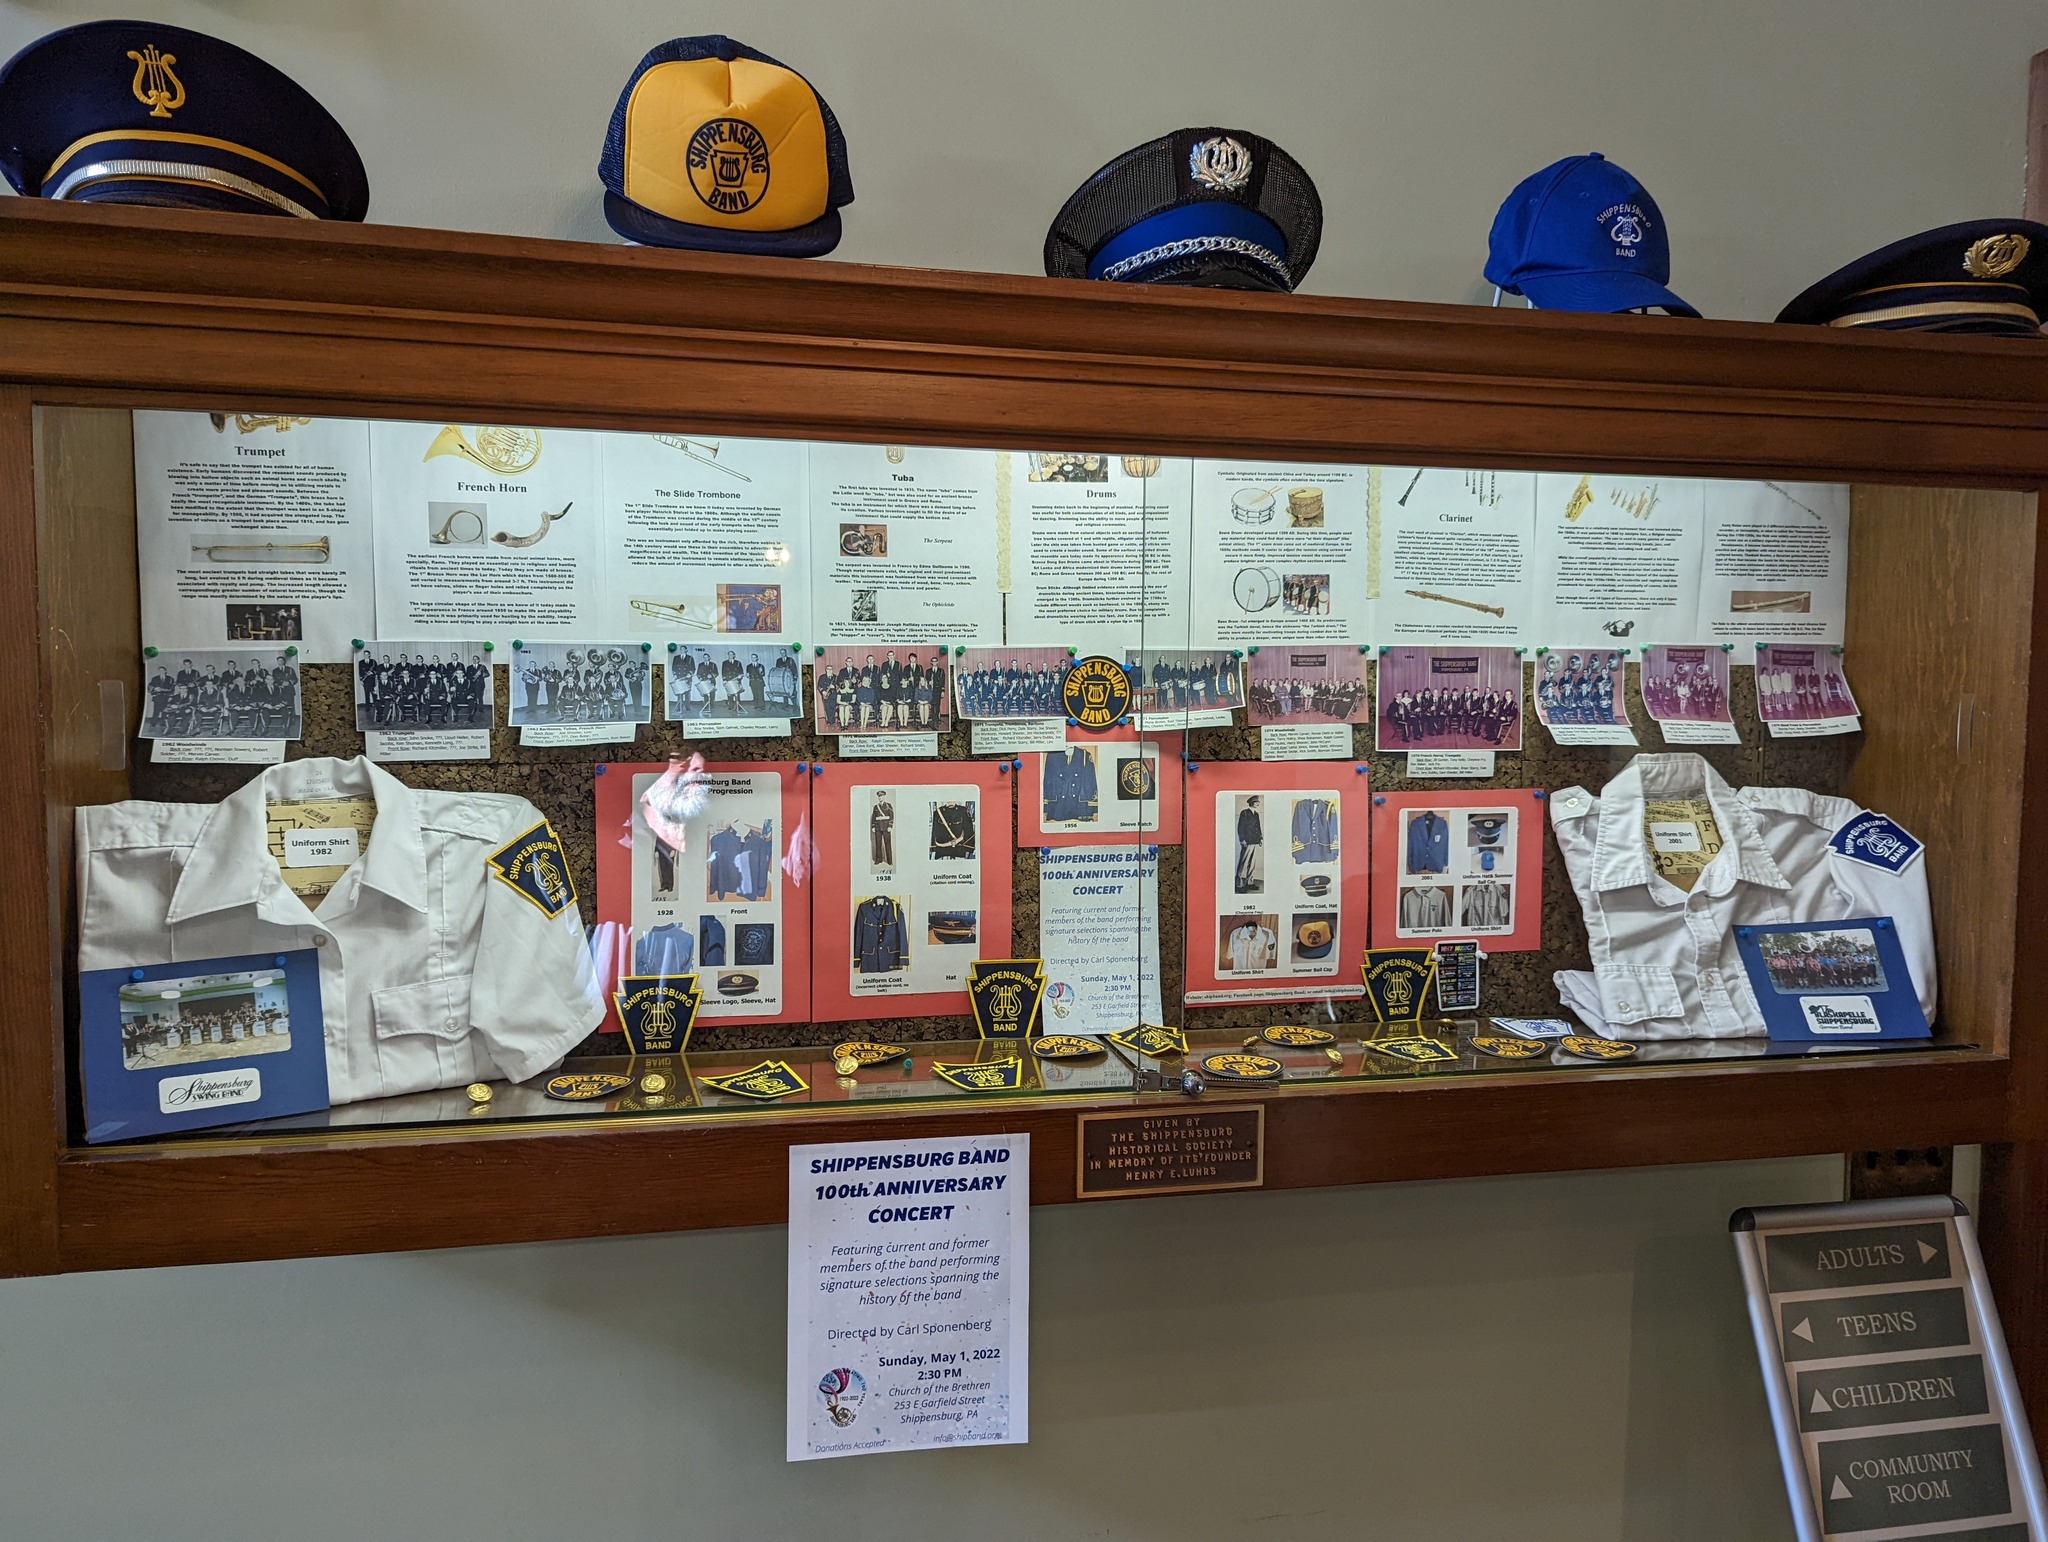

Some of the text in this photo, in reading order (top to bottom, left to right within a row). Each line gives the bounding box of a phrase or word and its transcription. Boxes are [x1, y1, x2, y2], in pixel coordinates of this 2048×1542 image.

[690, 123, 768, 174] SHIPPENSBURG
[708, 187, 750, 210] BAND
[1597, 204, 1651, 228] SHIPPENSBURG
[1616, 248, 1636, 257] BAND
[235, 446, 285, 458] Trumpet
[892, 474, 914, 482] Tuba
[458, 482, 527, 493] French Horn
[655, 489, 741, 499] The Slide Trombone
[1086, 489, 1117, 498] Drums
[1439, 514, 1473, 522] Clarinet
[1067, 662, 1126, 698] SHIPPENSBURG
[1081, 707, 1111, 724] BAND
[708, 787, 753, 795] Progression
[1845, 820, 1888, 854] SHIPPENSBURG
[510, 841, 558, 880] SHIPPENSBURG
[1040, 853, 1156, 864] SHIPPENSBURG BAND
[1889, 845, 1909, 863] BAND
[1042, 869, 1155, 880] 100th ANNIVERSARY
[1073, 886, 1123, 895] CONCERT
[1368, 958, 1428, 980] SHIPPENSBURG
[974, 971, 1038, 993] SHIPPENSBURG
[623, 987, 694, 1011] SHIPPENSBURG
[1389, 1006, 1409, 1016] BAND
[993, 1023, 1018, 1031] BAND
[645, 1040, 671, 1050] BAND
[165, 1077, 254, 1105] Shippensburg
[192, 1092, 220, 1102] SWING
[1144, 1118, 1200, 1128] GIVEN BY
[1112, 1127, 1233, 1142] THE SHIPPENSBURG
[1109, 1141, 1233, 1155] HISTORICAL SOCIETY
[810, 1149, 1010, 1173] SHIPPENSBURG BAND
[1090, 1161, 1101, 1169] IN
[1109, 1157, 1155, 1168] MEMORY
[1161, 1156, 1173, 1165] OF
[1126, 1170, 1164, 1181] HENRY
[816, 1175, 1007, 1200] 100th ANNIVERSARY
[868, 1205, 954, 1223] CONCERT
[831, 1238, 989, 1257] Featuring current and former
[820, 1254, 1000, 1274] members of the band performing
[1816, 1244, 1905, 1272] ADULTS
[820, 1270, 999, 1293] signature selections spanning the
[859, 1289, 961, 1307] history of the band
[828, 1319, 992, 1340] Directed by Carl Sponenberg
[1837, 1311, 1917, 1338] TEENS
[879, 1348, 1000, 1368] Sunday, May 1, 2022
[918, 1368, 962, 1380] 2:30 PM
[888, 1381, 990, 1397] Church of the Brethren
[1832, 1377, 1956, 1409] CHILDREN
[894, 1395, 985, 1411] 253 E Garfield Street
[900, 1409, 978, 1424] Shippensburg, PA
[815, 1440, 885, 1453] Donations Accepted
[1849, 1449, 1973, 1480] COMMUNITY
[1887, 1480, 1952, 1504] ROOM
